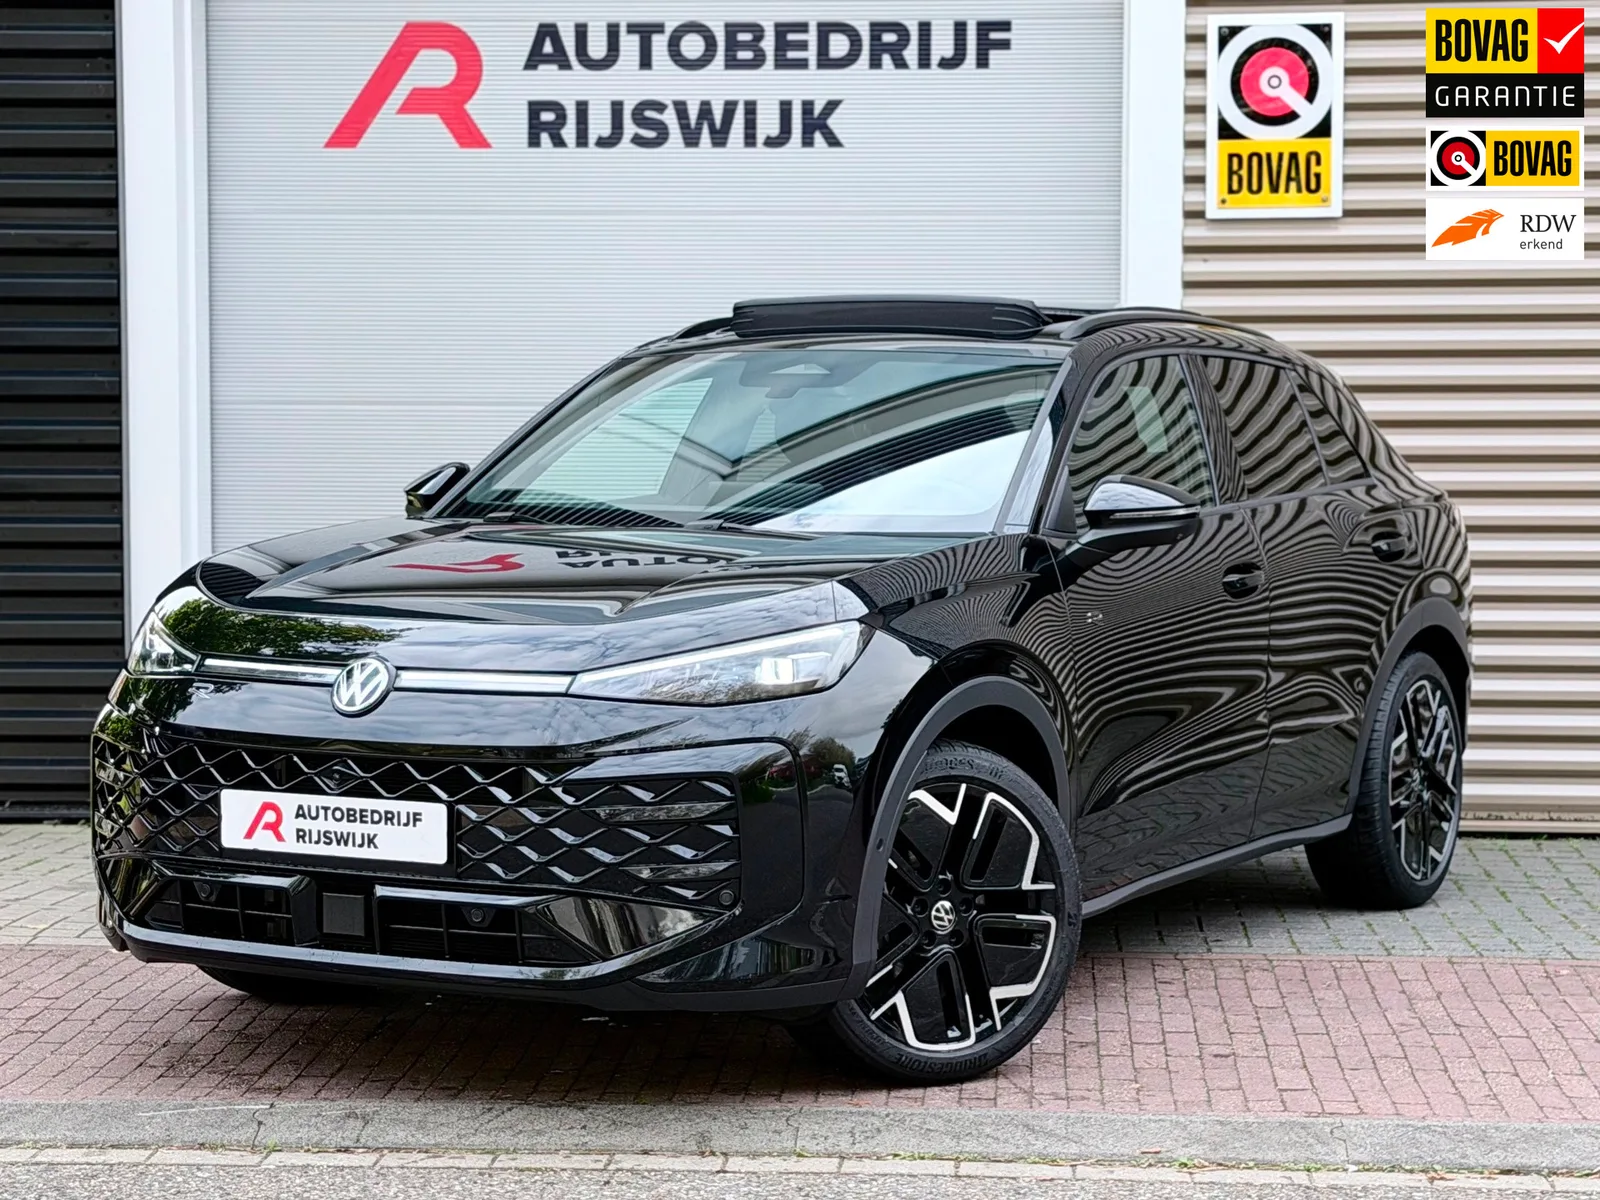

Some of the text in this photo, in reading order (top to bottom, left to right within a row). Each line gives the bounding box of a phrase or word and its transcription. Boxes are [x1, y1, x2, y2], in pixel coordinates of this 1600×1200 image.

[523, 20, 1012, 71] AUTOBEDRIJF
[527, 99, 845, 149] RIJSWIJK
[1227, 150, 1322, 196] BOVAG
[294, 803, 423, 828] AUTOBEDRIJF
[295, 828, 380, 850] RIJSWIJK
